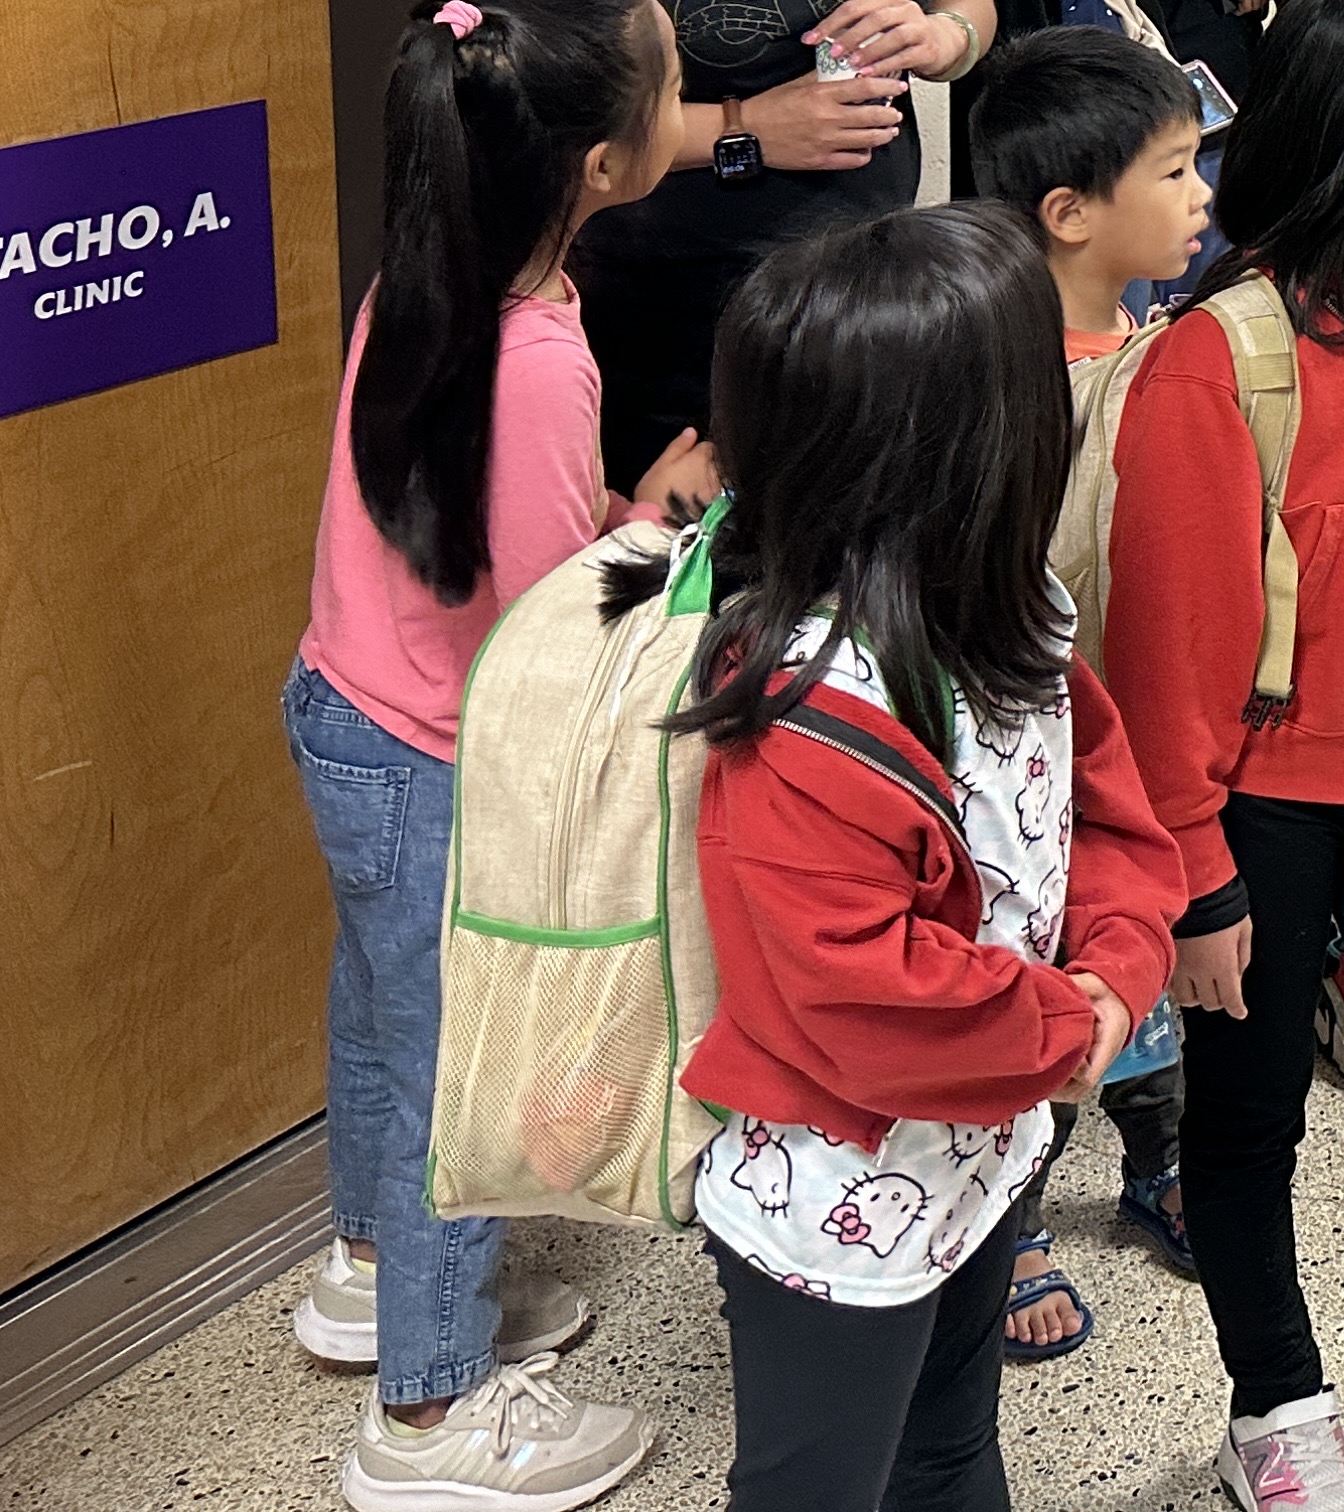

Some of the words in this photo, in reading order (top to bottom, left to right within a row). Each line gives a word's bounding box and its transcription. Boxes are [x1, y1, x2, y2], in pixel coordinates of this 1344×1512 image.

[0, 205, 174, 281] ACHO,
[184, 191, 230, 237] A.
[34, 271, 144, 319] CLINIC
